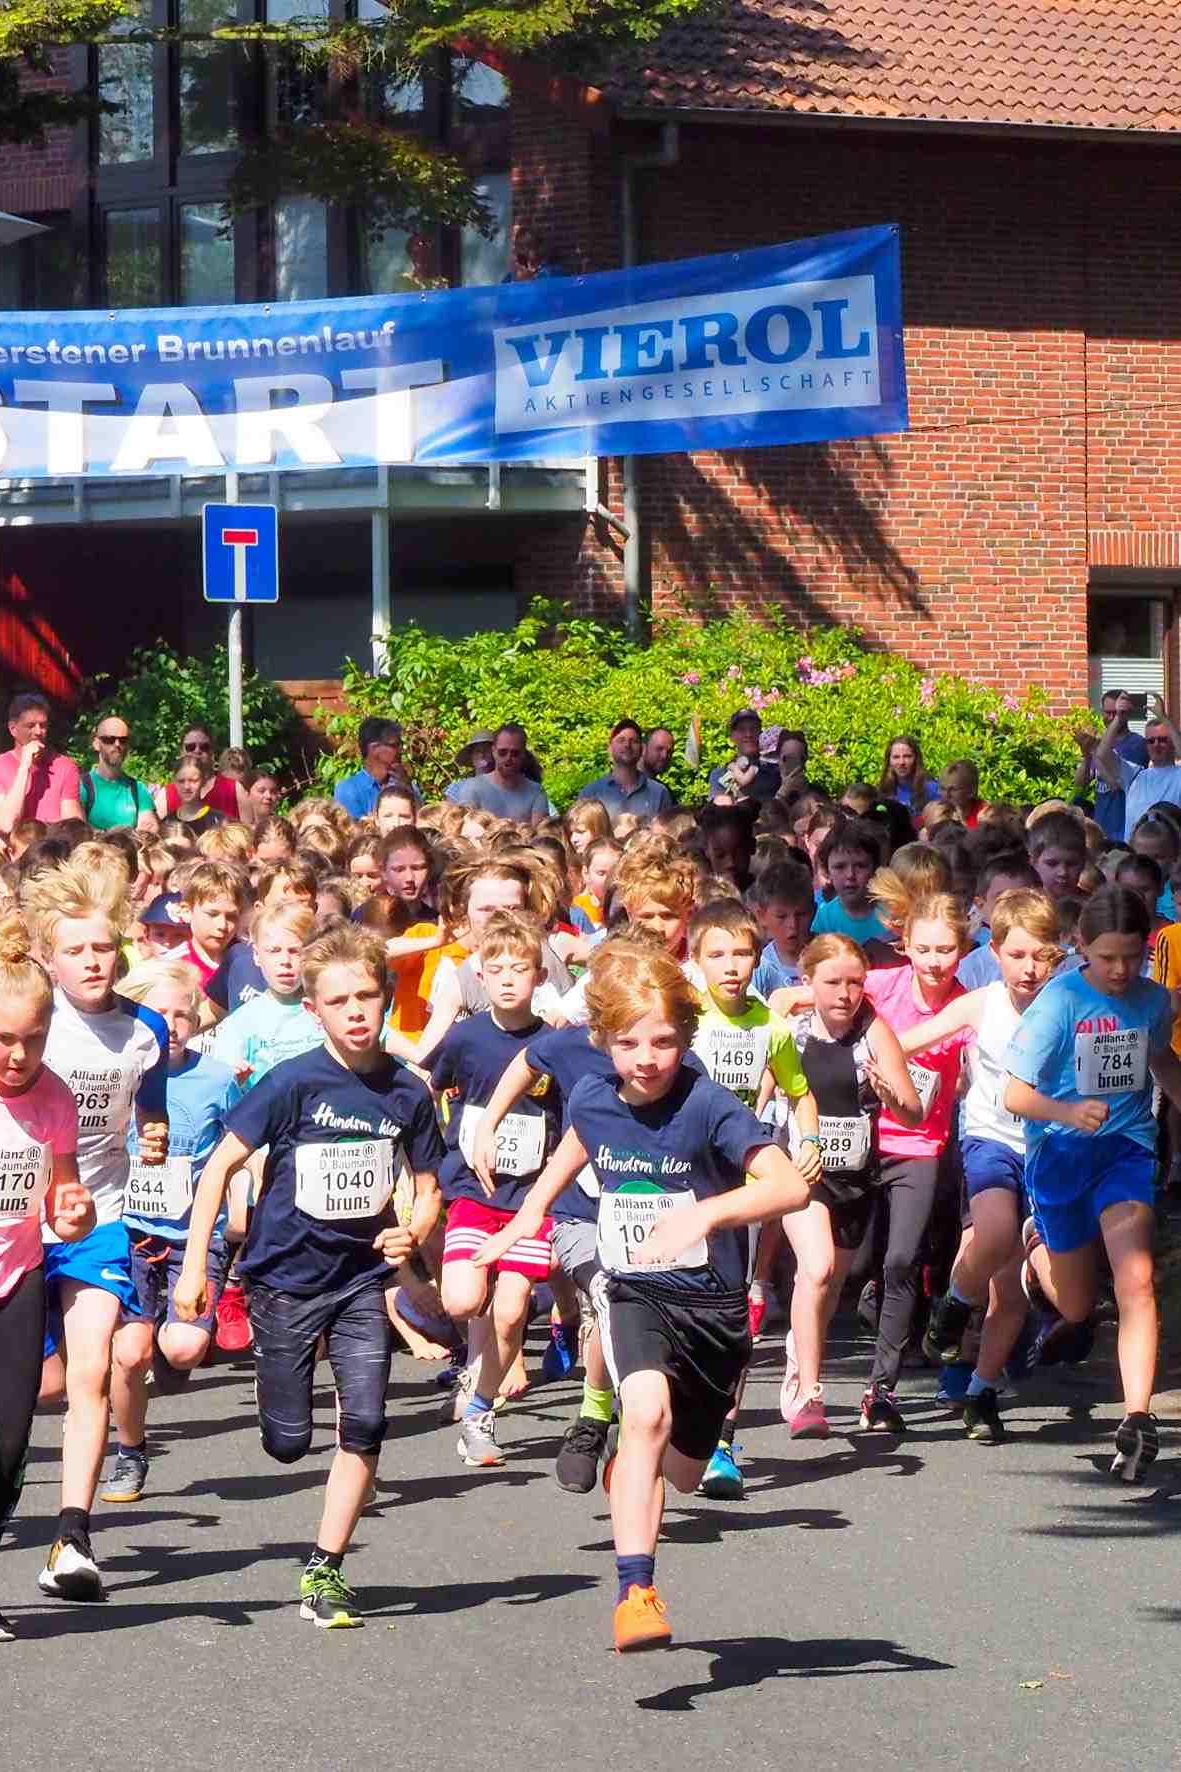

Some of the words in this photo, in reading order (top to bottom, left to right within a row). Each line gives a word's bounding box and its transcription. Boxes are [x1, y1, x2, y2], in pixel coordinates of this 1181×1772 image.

[158, 321, 396, 363] Brunnenlauf
[505, 299, 871, 388] VIEROL
[524, 370, 872, 413] AKTIENGESELLSCHAFT
[1094, 1034, 1125, 1045] Allianz
[711, 1050, 754, 1066] 1469
[1101, 1053, 1133, 1071] 784
[70, 1070, 108, 1082] Allianz
[1098, 1073, 1134, 1089] bruns
[320, 1147, 361, 1159] Allianz
[130, 1179, 164, 1196] 644
[323, 1170, 375, 1191] 1040
[128, 1194, 168, 1213] bruns
[326, 1194, 371, 1212] bruns
[613, 1197, 655, 1210] Allianz
